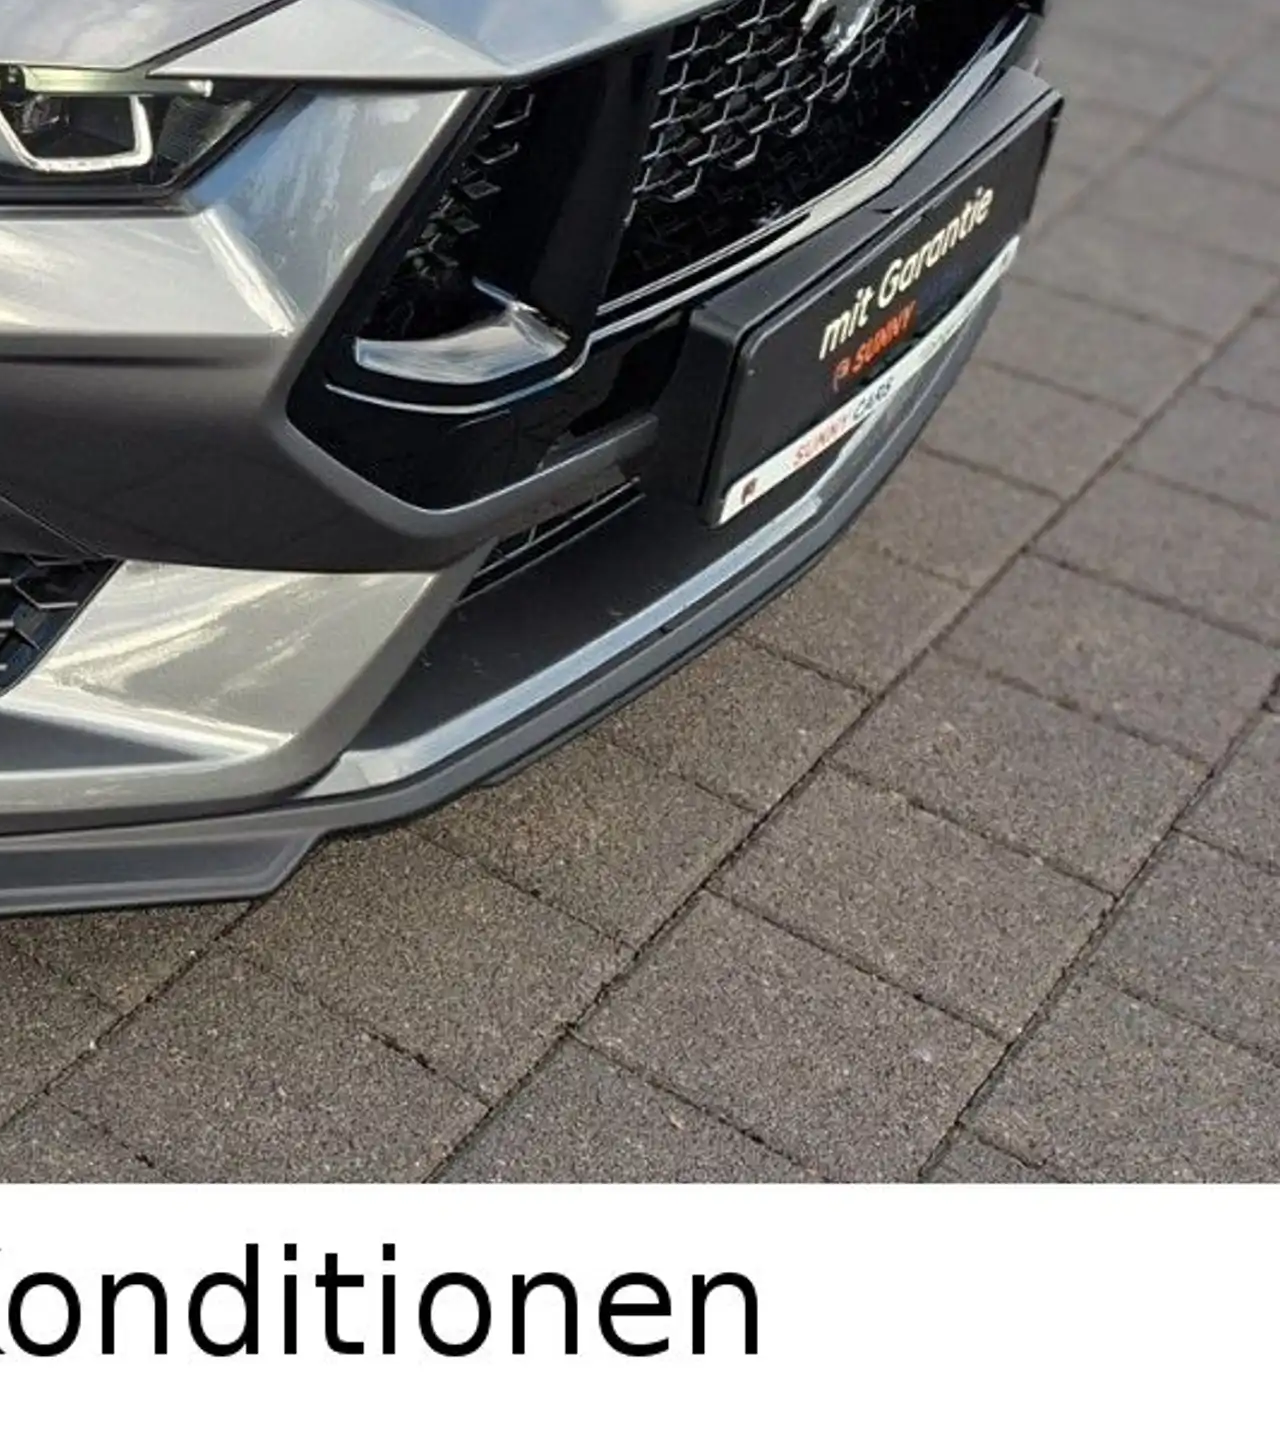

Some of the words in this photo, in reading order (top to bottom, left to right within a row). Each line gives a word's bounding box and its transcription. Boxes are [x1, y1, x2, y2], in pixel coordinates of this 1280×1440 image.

[819, 285, 874, 360] mit
[877, 186, 994, 308] Garantie
[851, 299, 917, 373] SUNNY
